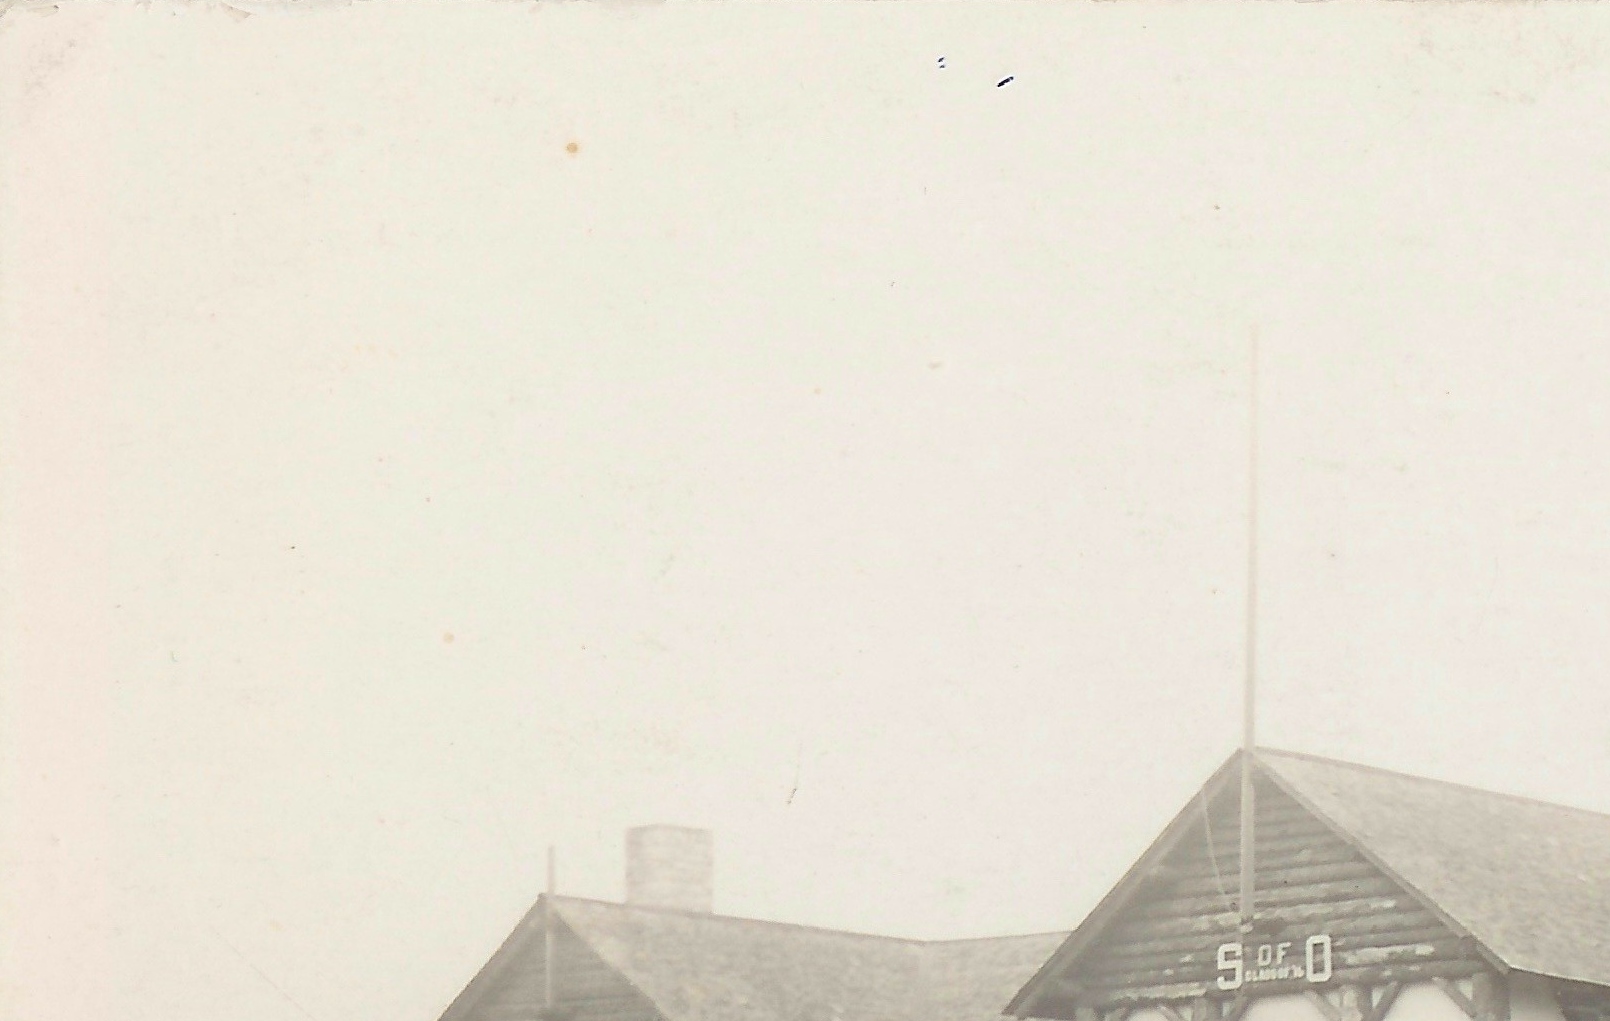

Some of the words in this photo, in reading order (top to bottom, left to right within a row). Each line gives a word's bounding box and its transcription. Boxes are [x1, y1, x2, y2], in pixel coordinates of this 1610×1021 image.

[1217, 942, 1243, 990] S
[1258, 941, 1292, 966] OF
[1306, 934, 1332, 982] O
